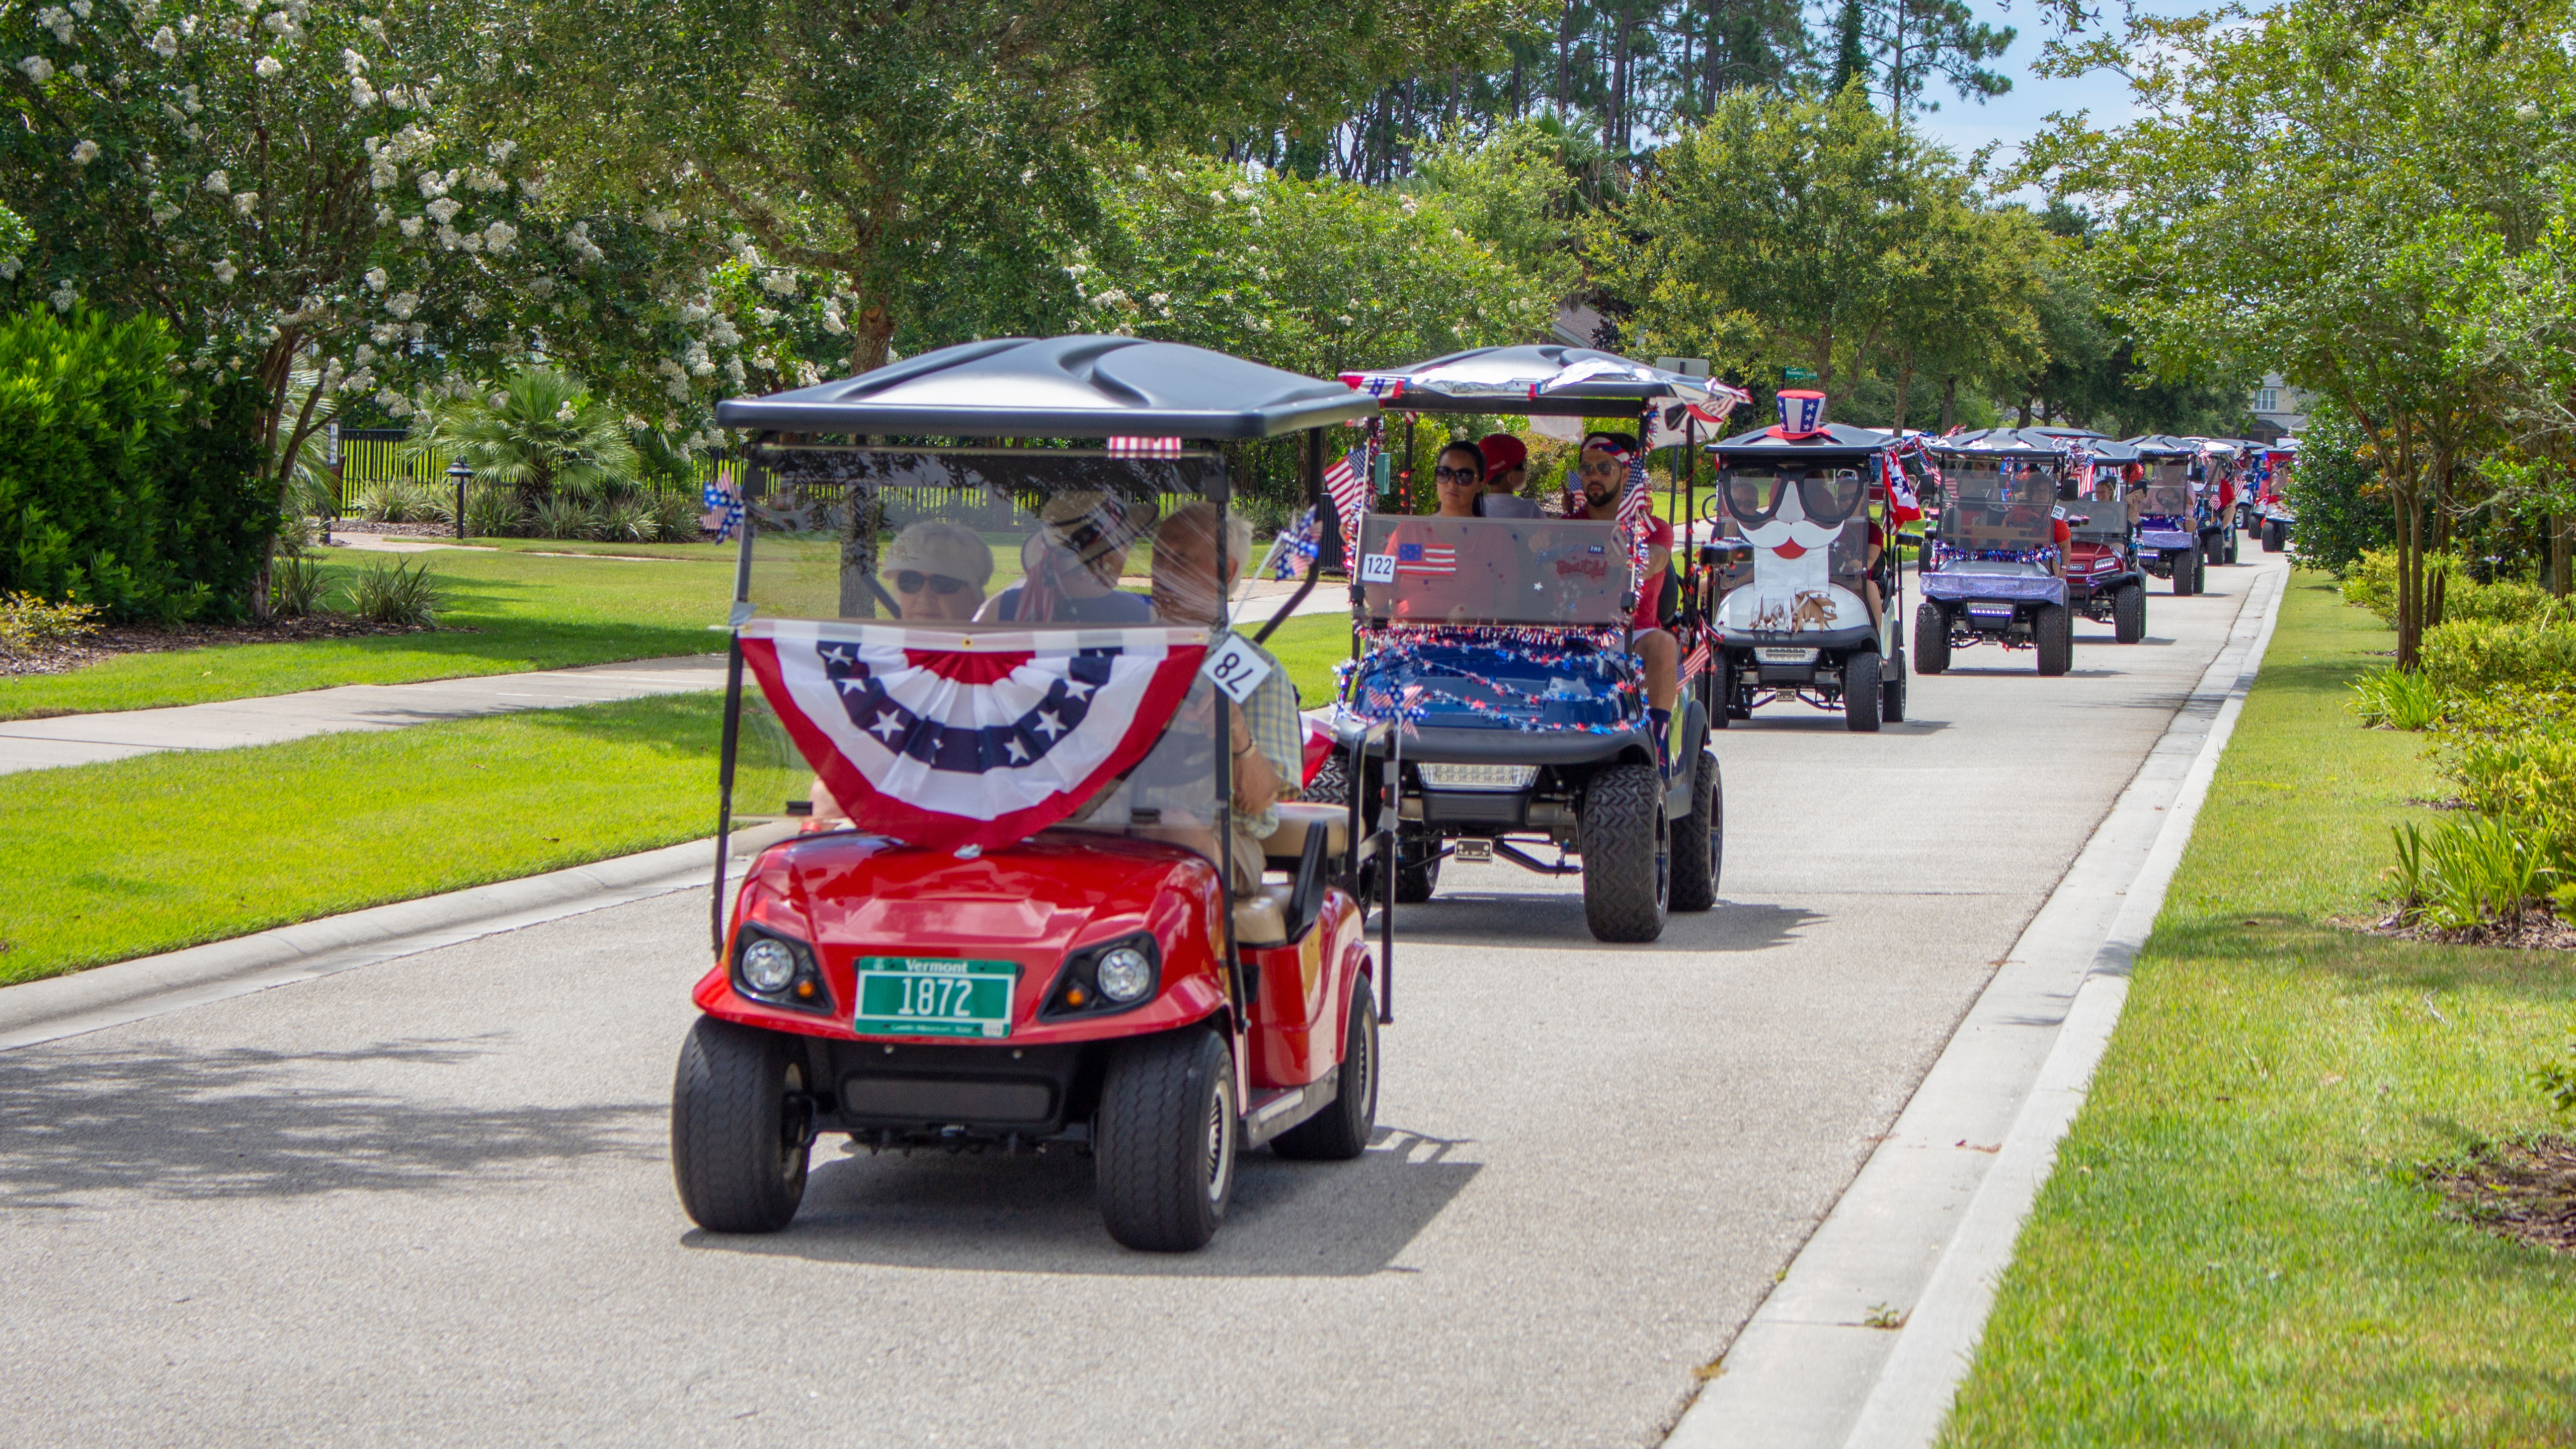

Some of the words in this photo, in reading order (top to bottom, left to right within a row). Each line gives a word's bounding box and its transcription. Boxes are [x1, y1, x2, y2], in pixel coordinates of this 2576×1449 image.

[2053, 507, 2062, 517] 79
[1368, 557, 1392, 575] 122
[1214, 652, 1254, 694] 78
[904, 959, 968, 973] Vermont
[897, 977, 973, 1017] 1872
